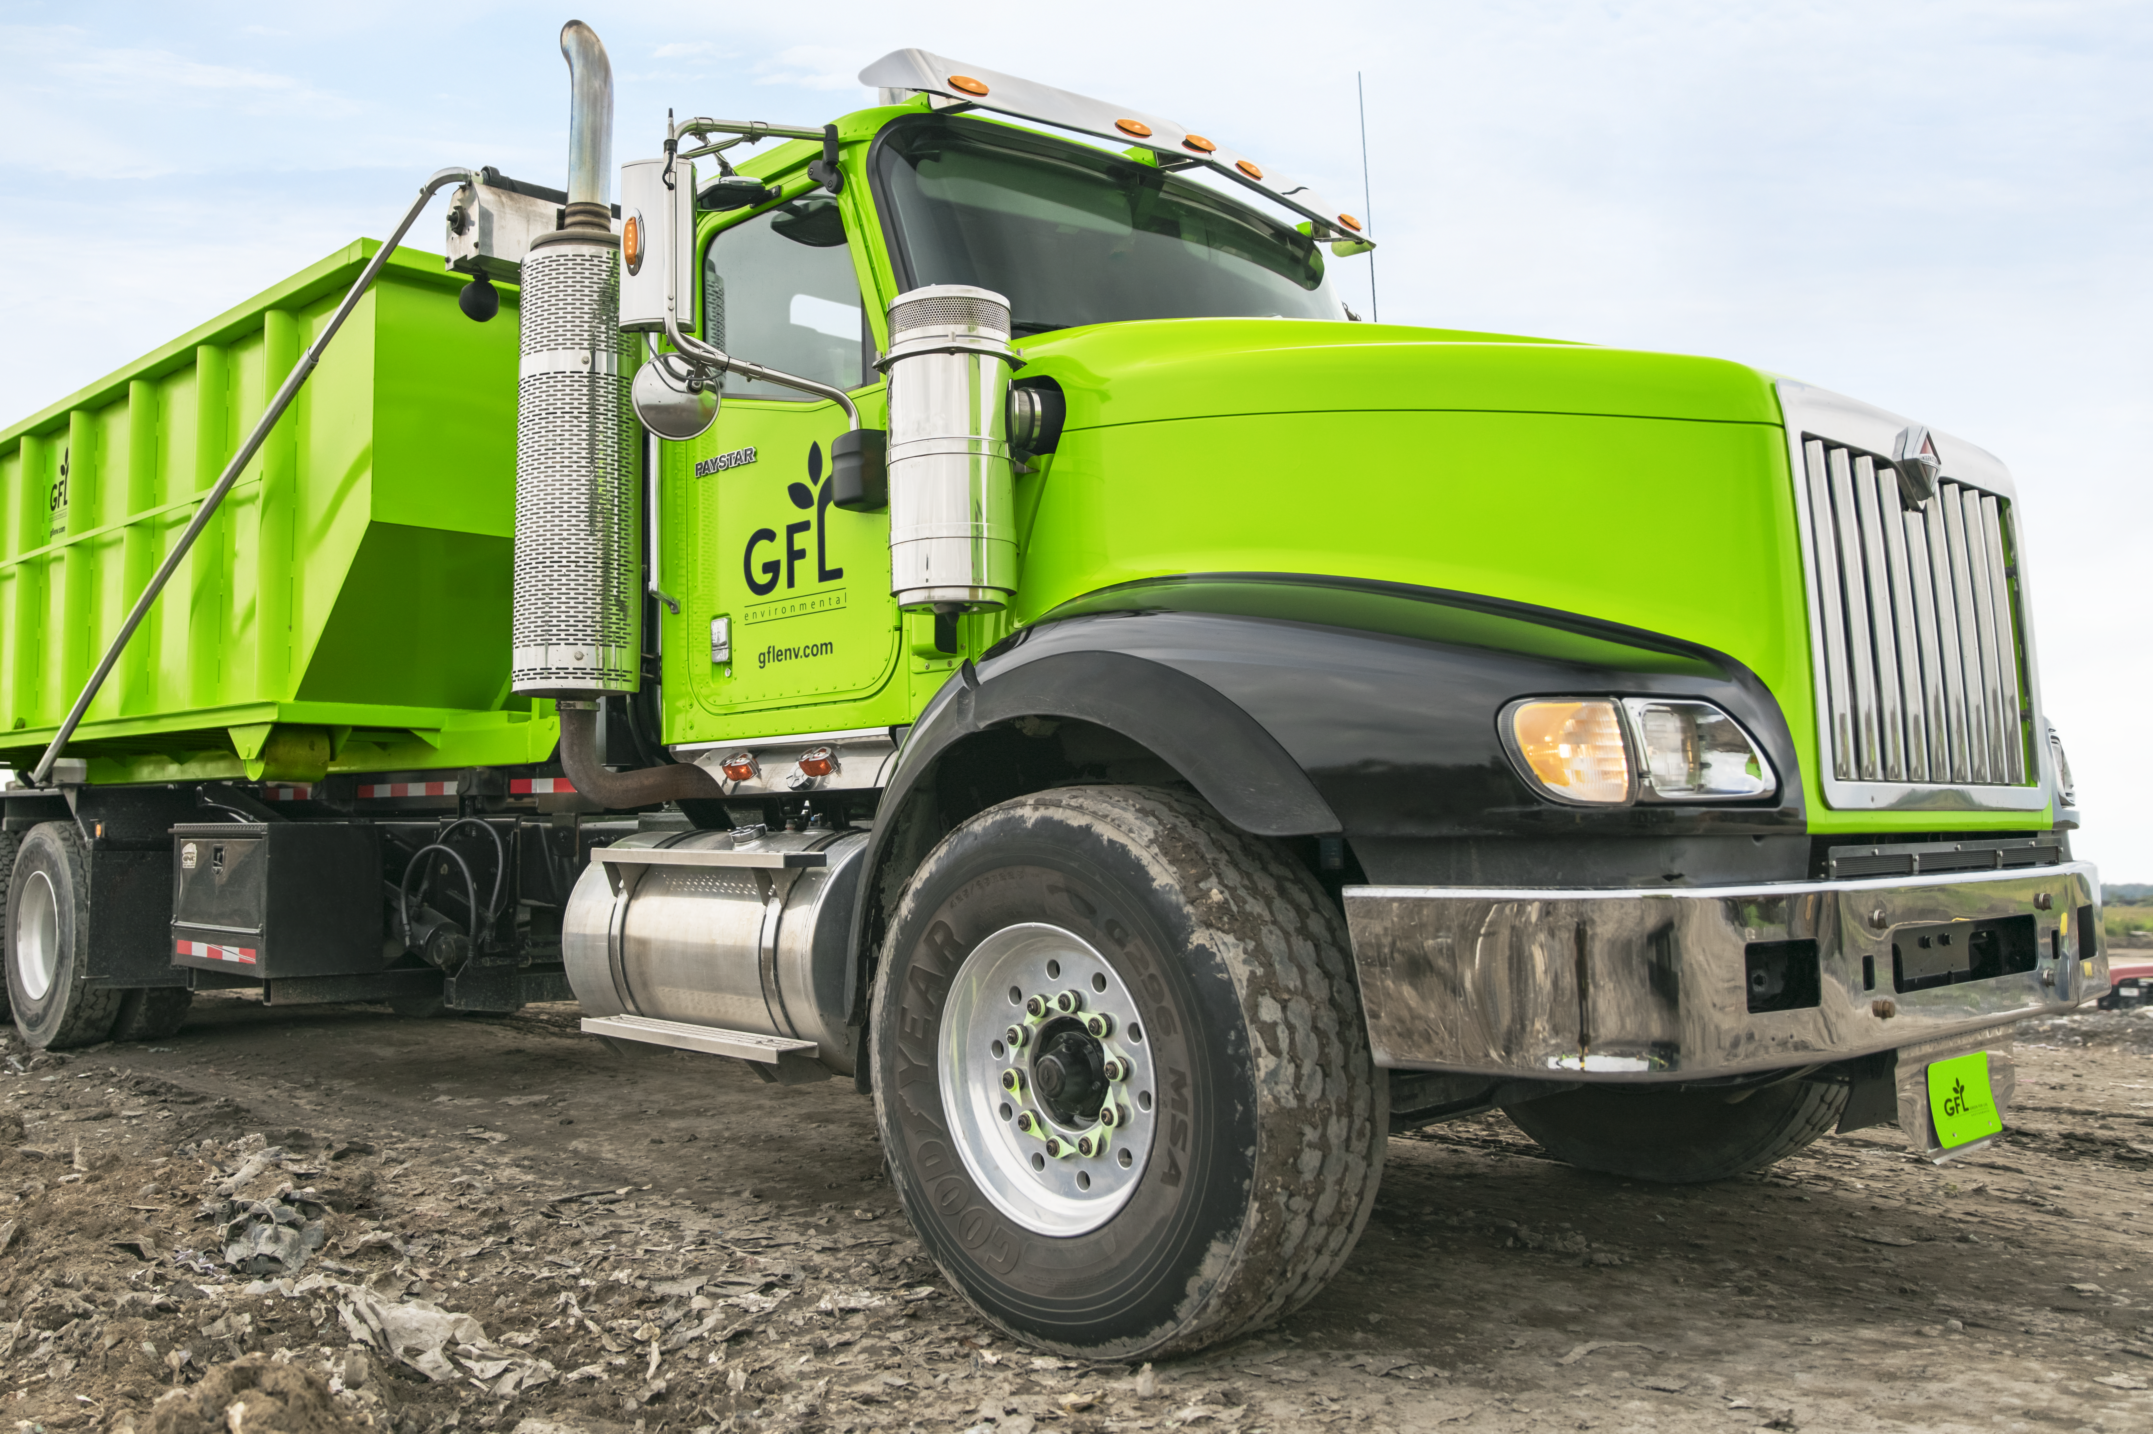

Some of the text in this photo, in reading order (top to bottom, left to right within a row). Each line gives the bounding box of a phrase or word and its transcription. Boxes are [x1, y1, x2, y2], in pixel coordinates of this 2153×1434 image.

[695, 446, 757, 478] PAYSTAR
[49, 468, 68, 511] GFL
[743, 478, 844, 596] GFL
[744, 592, 847, 621] environmental
[758, 641, 834, 669] gflenv.com
[899, 919, 1020, 1275] GOODYEAR
[1944, 1090, 1969, 1116] GFL
[1160, 1066, 1189, 1188] MSA
